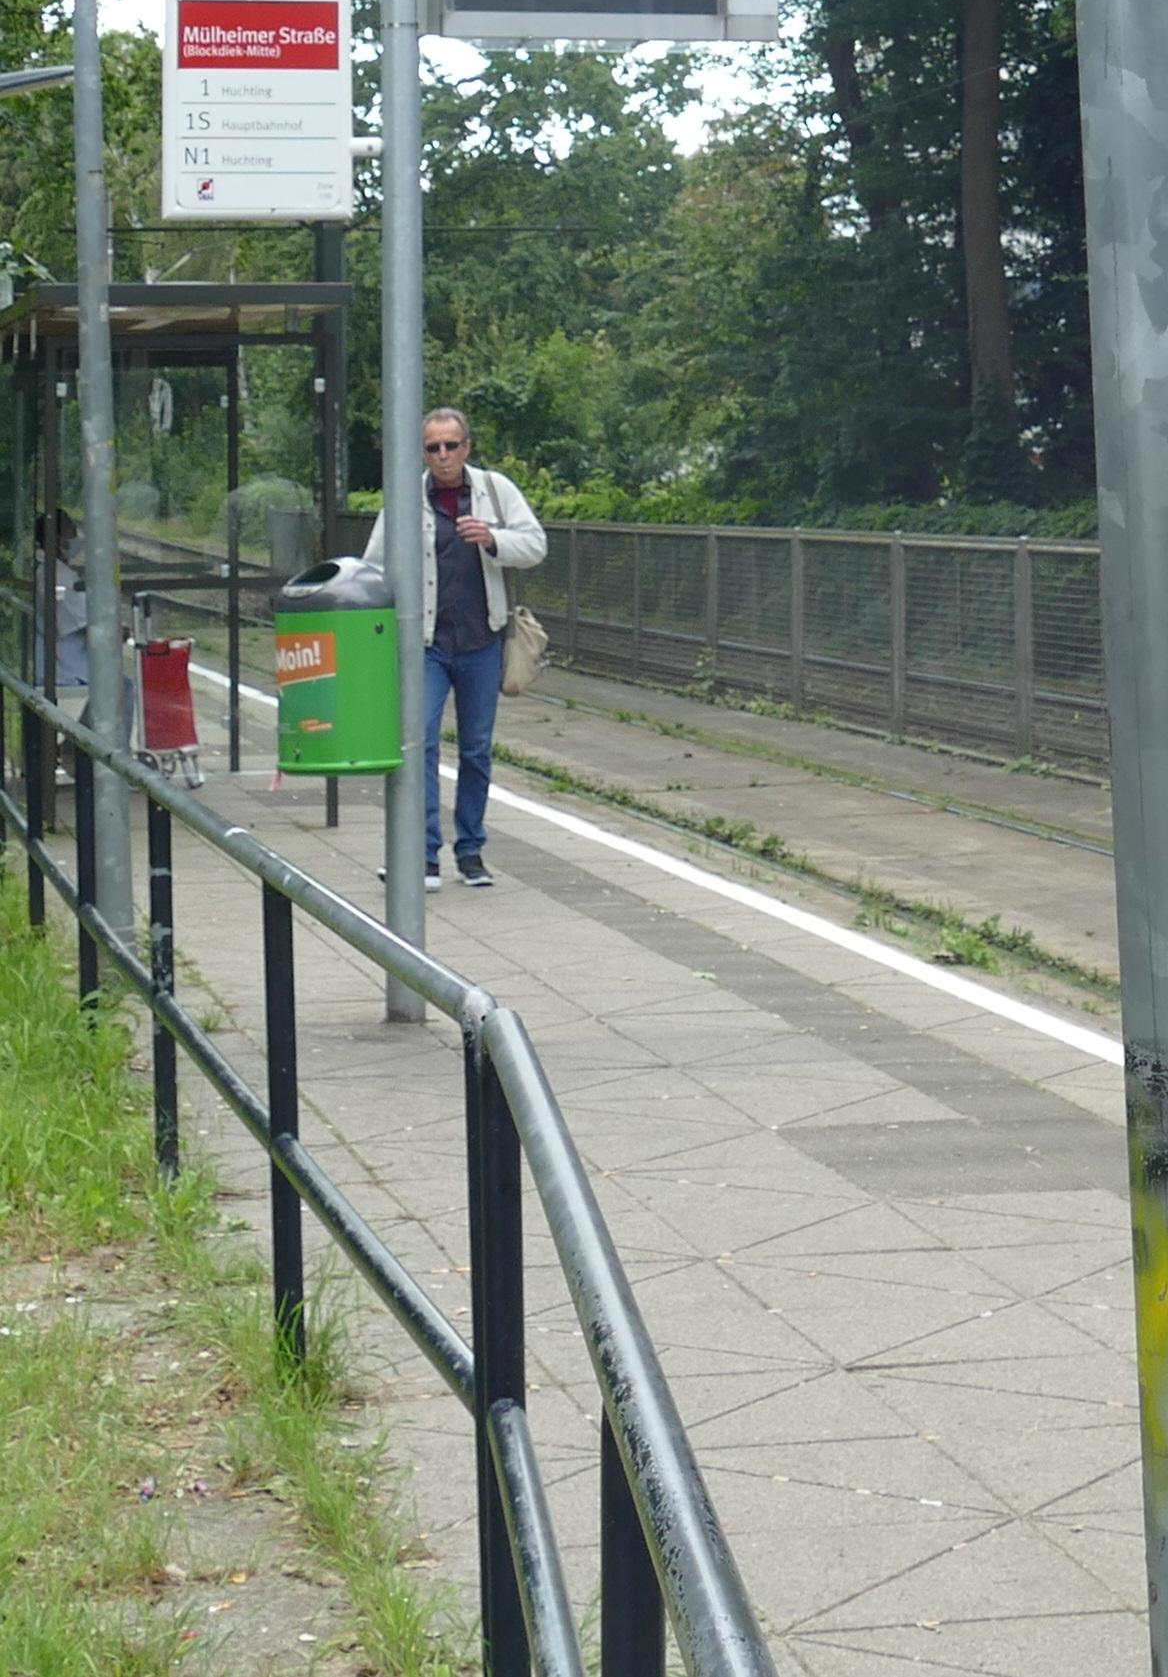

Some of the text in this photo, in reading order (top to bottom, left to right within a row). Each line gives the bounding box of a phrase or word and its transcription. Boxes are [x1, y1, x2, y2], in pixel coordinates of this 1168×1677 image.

[183, 26, 336, 45] Mülheimer Straße
[183, 45, 281, 58] (Blockdiek-Mitte)
[201, 79, 273, 99] 1 Huchting
[221, 120, 303, 131] Hauptbahnhof
[221, 155, 274, 168] Huchting
